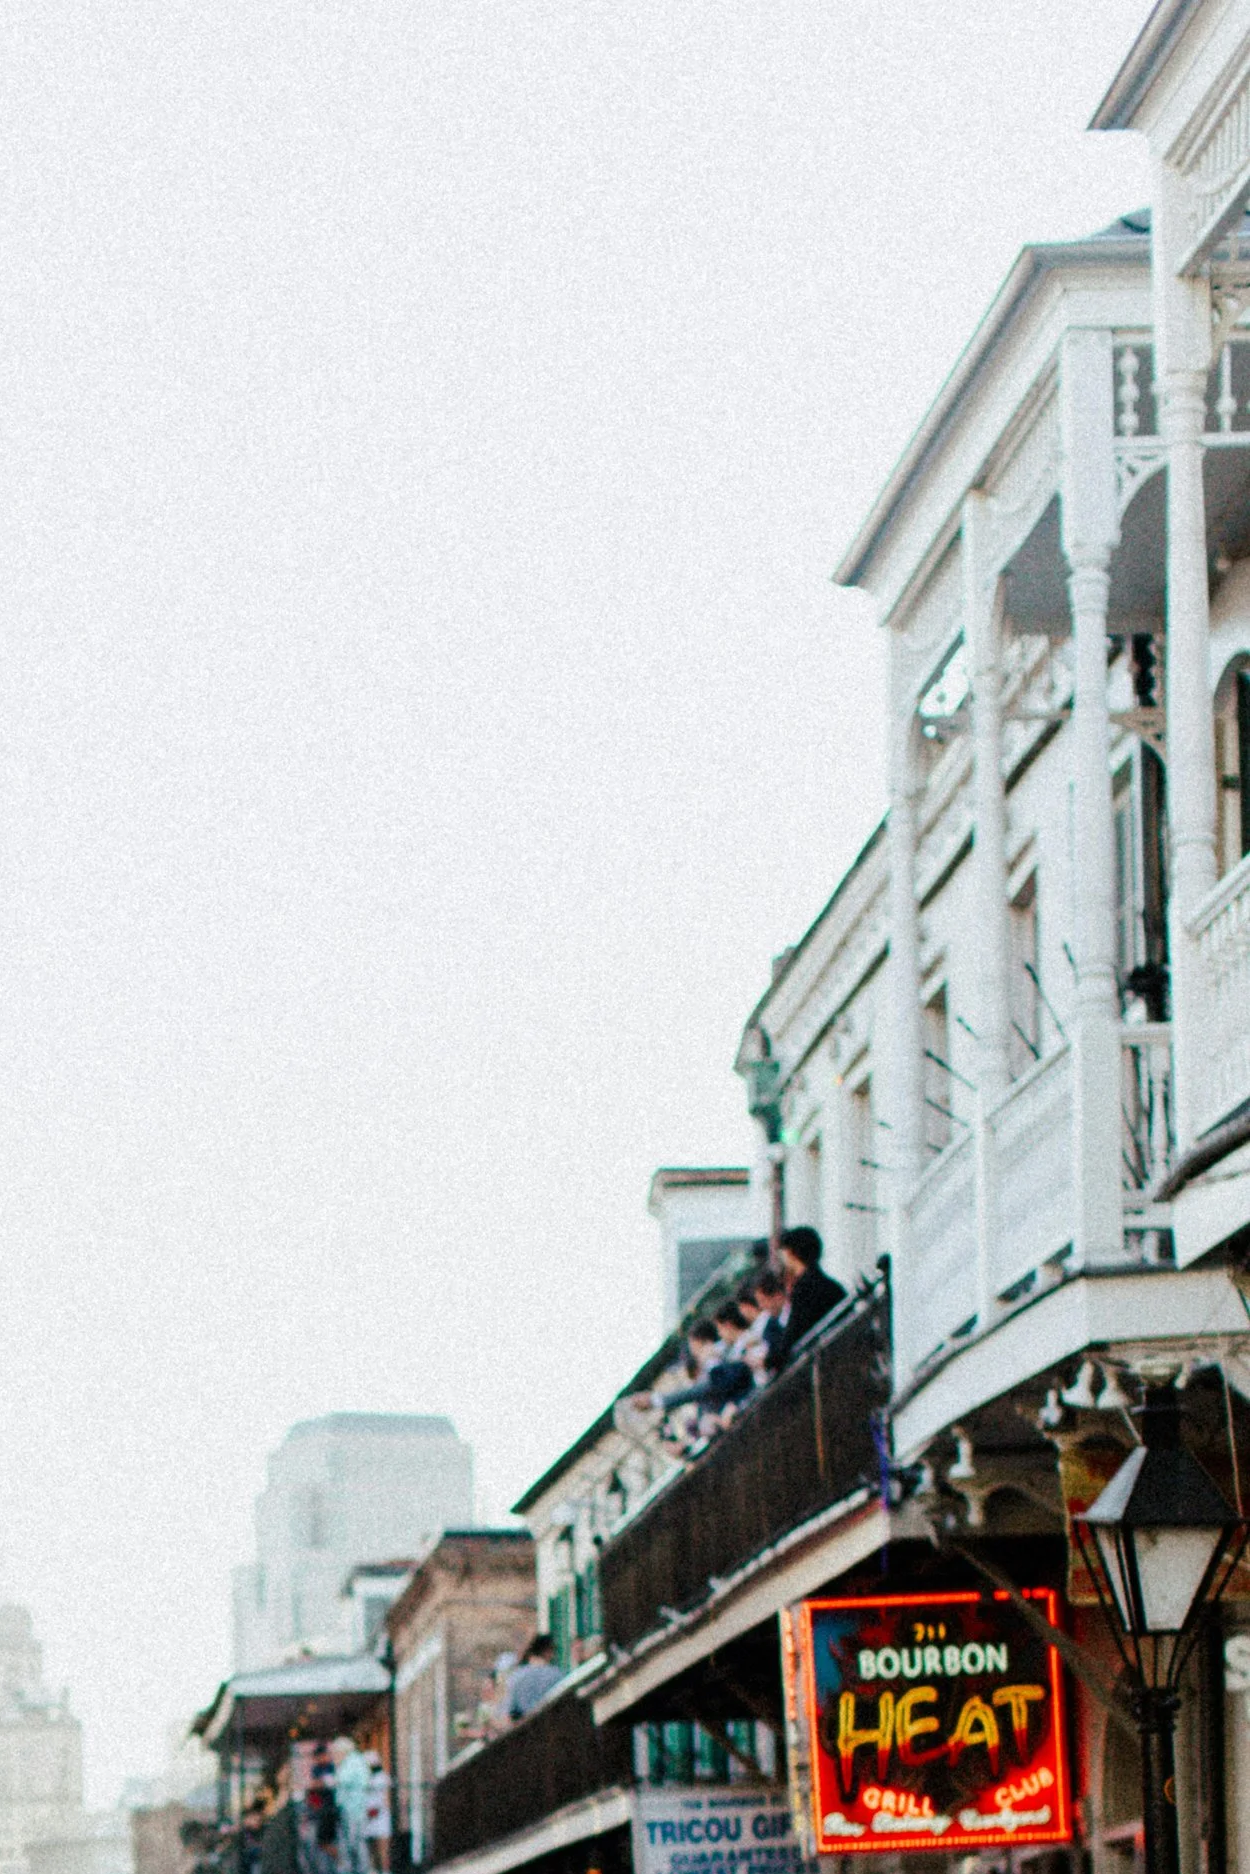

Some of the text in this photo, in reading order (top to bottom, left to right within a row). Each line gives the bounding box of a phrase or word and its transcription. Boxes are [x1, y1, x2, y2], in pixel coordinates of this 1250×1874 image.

[912, 1621, 947, 1642] 711
[858, 1642, 1008, 1680] BOURBON
[838, 1685, 1046, 1786] HEAT
[863, 1787, 935, 1817] GRILL
[646, 1815, 742, 1845] TRICOU
[752, 1812, 792, 1840] GIF
